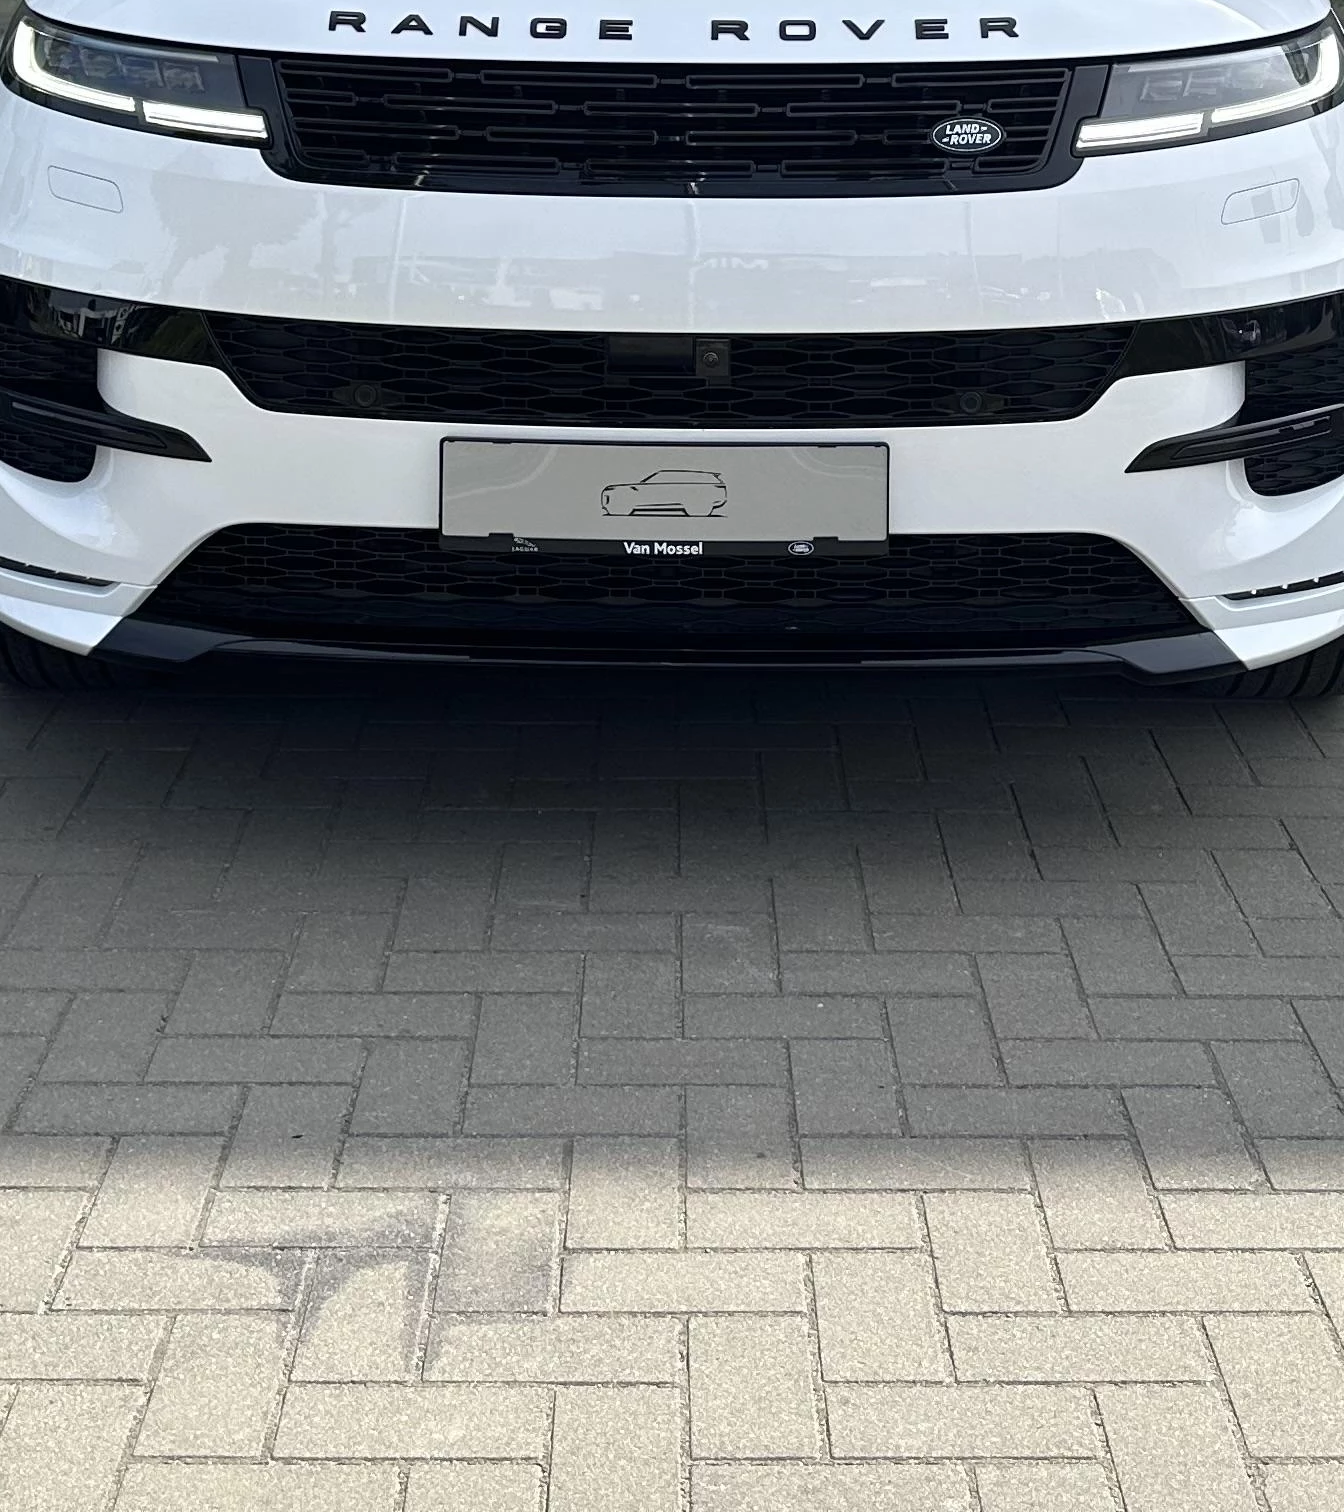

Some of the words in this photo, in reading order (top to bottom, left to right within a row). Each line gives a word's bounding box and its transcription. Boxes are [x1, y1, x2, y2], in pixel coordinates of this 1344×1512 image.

[328, 9, 634, 41] RANGE
[710, 16, 1020, 42] ROVER
[945, 123, 980, 135] LAND
[949, 133, 992, 145] ROVER
[623, 541, 650, 556] Van
[653, 540, 703, 556] Mossel
